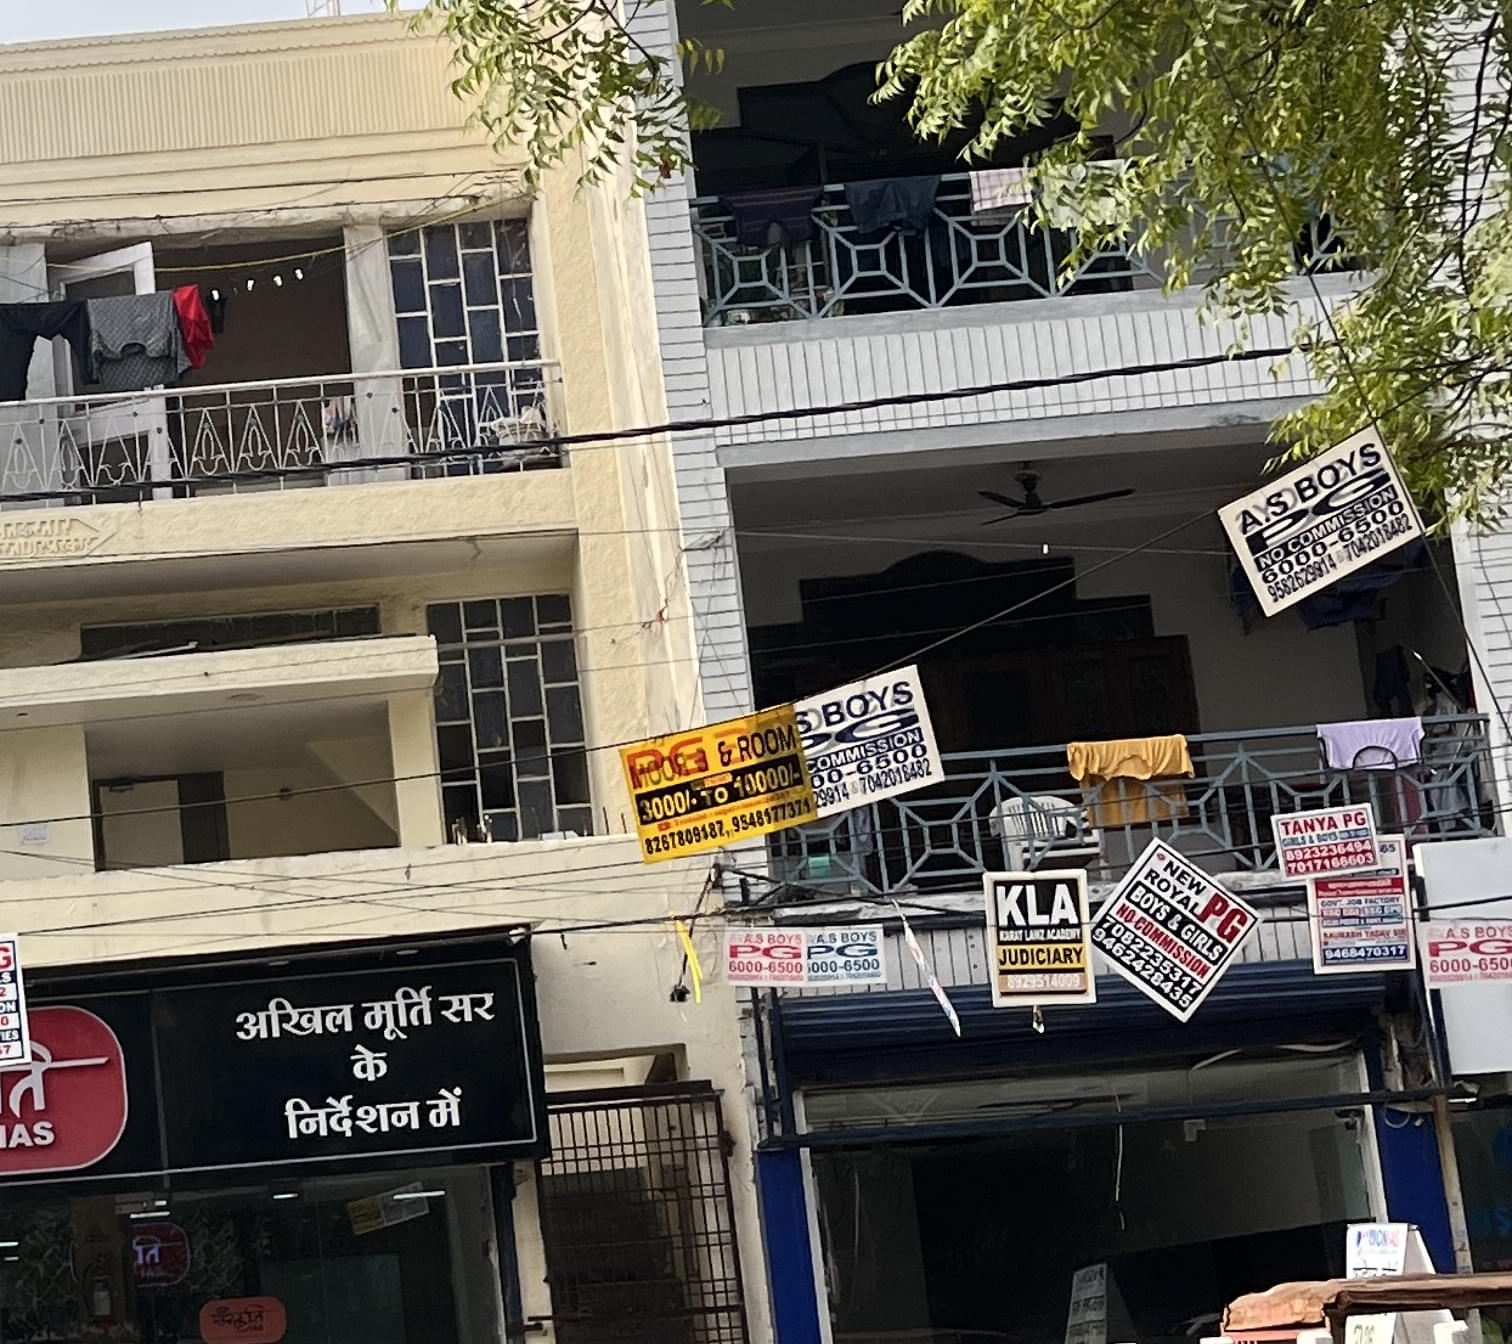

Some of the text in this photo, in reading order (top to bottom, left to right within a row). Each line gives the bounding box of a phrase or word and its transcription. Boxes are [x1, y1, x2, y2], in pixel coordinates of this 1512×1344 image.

[1294, 443, 1381, 503] BOYS
[1246, 468, 1391, 556] PG
[1259, 487, 1398, 569] NO COMMISSION
[1262, 501, 1405, 584] 6000-6500
[821, 681, 914, 727] BOYS
[627, 725, 796, 789] PG & ROOM
[810, 744, 928, 789] 00-6500
[699, 787, 728, 806] TO
[1280, 816, 1338, 836] TANYA
[1343, 811, 1366, 828] PG
[1163, 860, 1207, 896] NEW
[996, 883, 1079, 927] KLA
[1129, 887, 1223, 961] BOYS & GIRLS
[1144, 868, 1248, 944] ROYAL PG
[729, 944, 802, 960] PG
[767, 933, 802, 945] BOYS
[807, 943, 878, 960] PG
[841, 931, 877, 943] BOYS
[999, 947, 1083, 965] JUDICIARY
[1101, 915, 1203, 995] 7082235317
[1429, 938, 1512, 957] PG
[808, 958, 880, 974] 000-6500
[1092, 927, 1193, 1008] 9462428435
[1430, 957, 1512, 973] 6000-650
[236, 985, 495, 1041] अखिल मूर्ति सर
[350, 1043, 388, 1082] के
[284, 1086, 463, 1139] निर्देशन में
